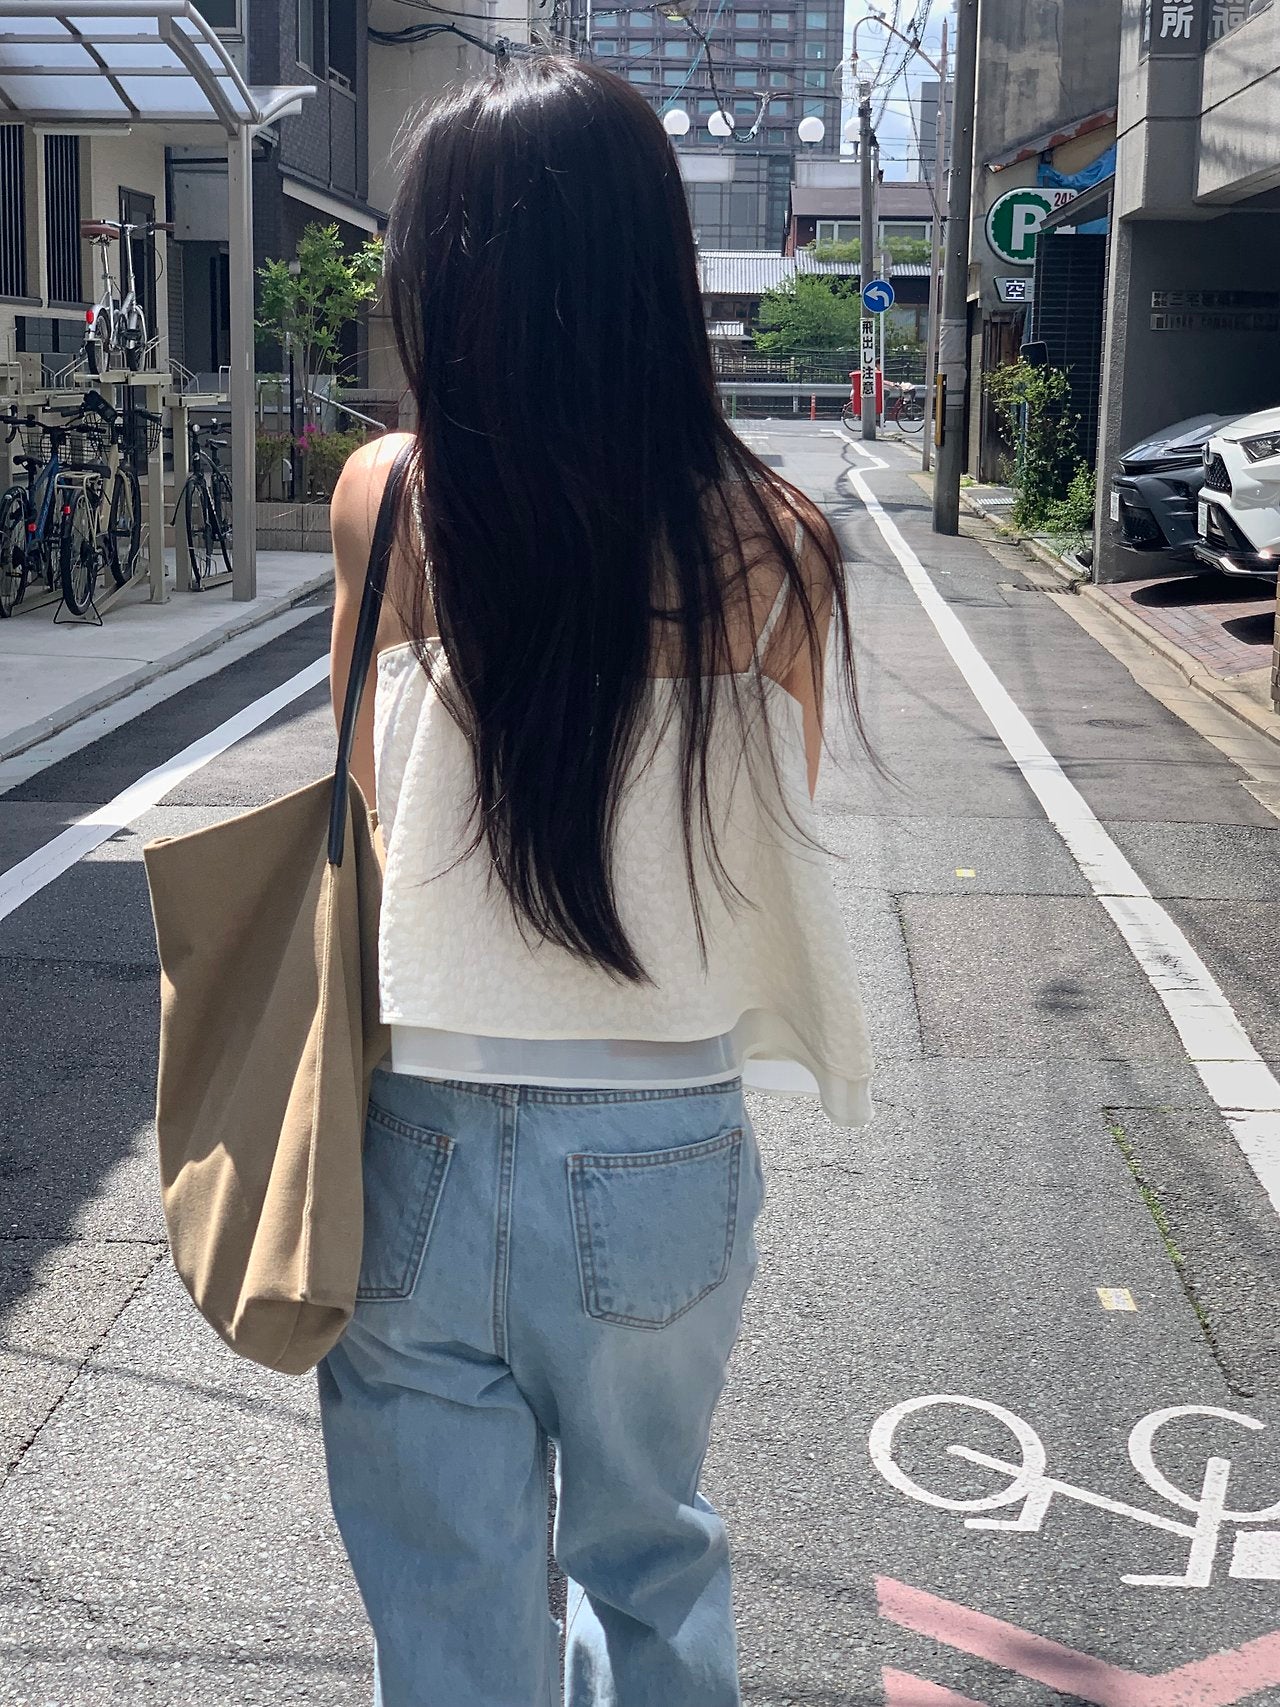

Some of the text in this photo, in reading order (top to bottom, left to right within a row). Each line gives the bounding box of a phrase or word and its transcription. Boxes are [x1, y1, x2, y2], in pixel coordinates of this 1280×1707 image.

[1159, 0, 1194, 39] 所
[1010, 204, 1047, 250] P
[1005, 280, 1025, 300] 空
[862, 320, 874, 395] 飛出し注意
